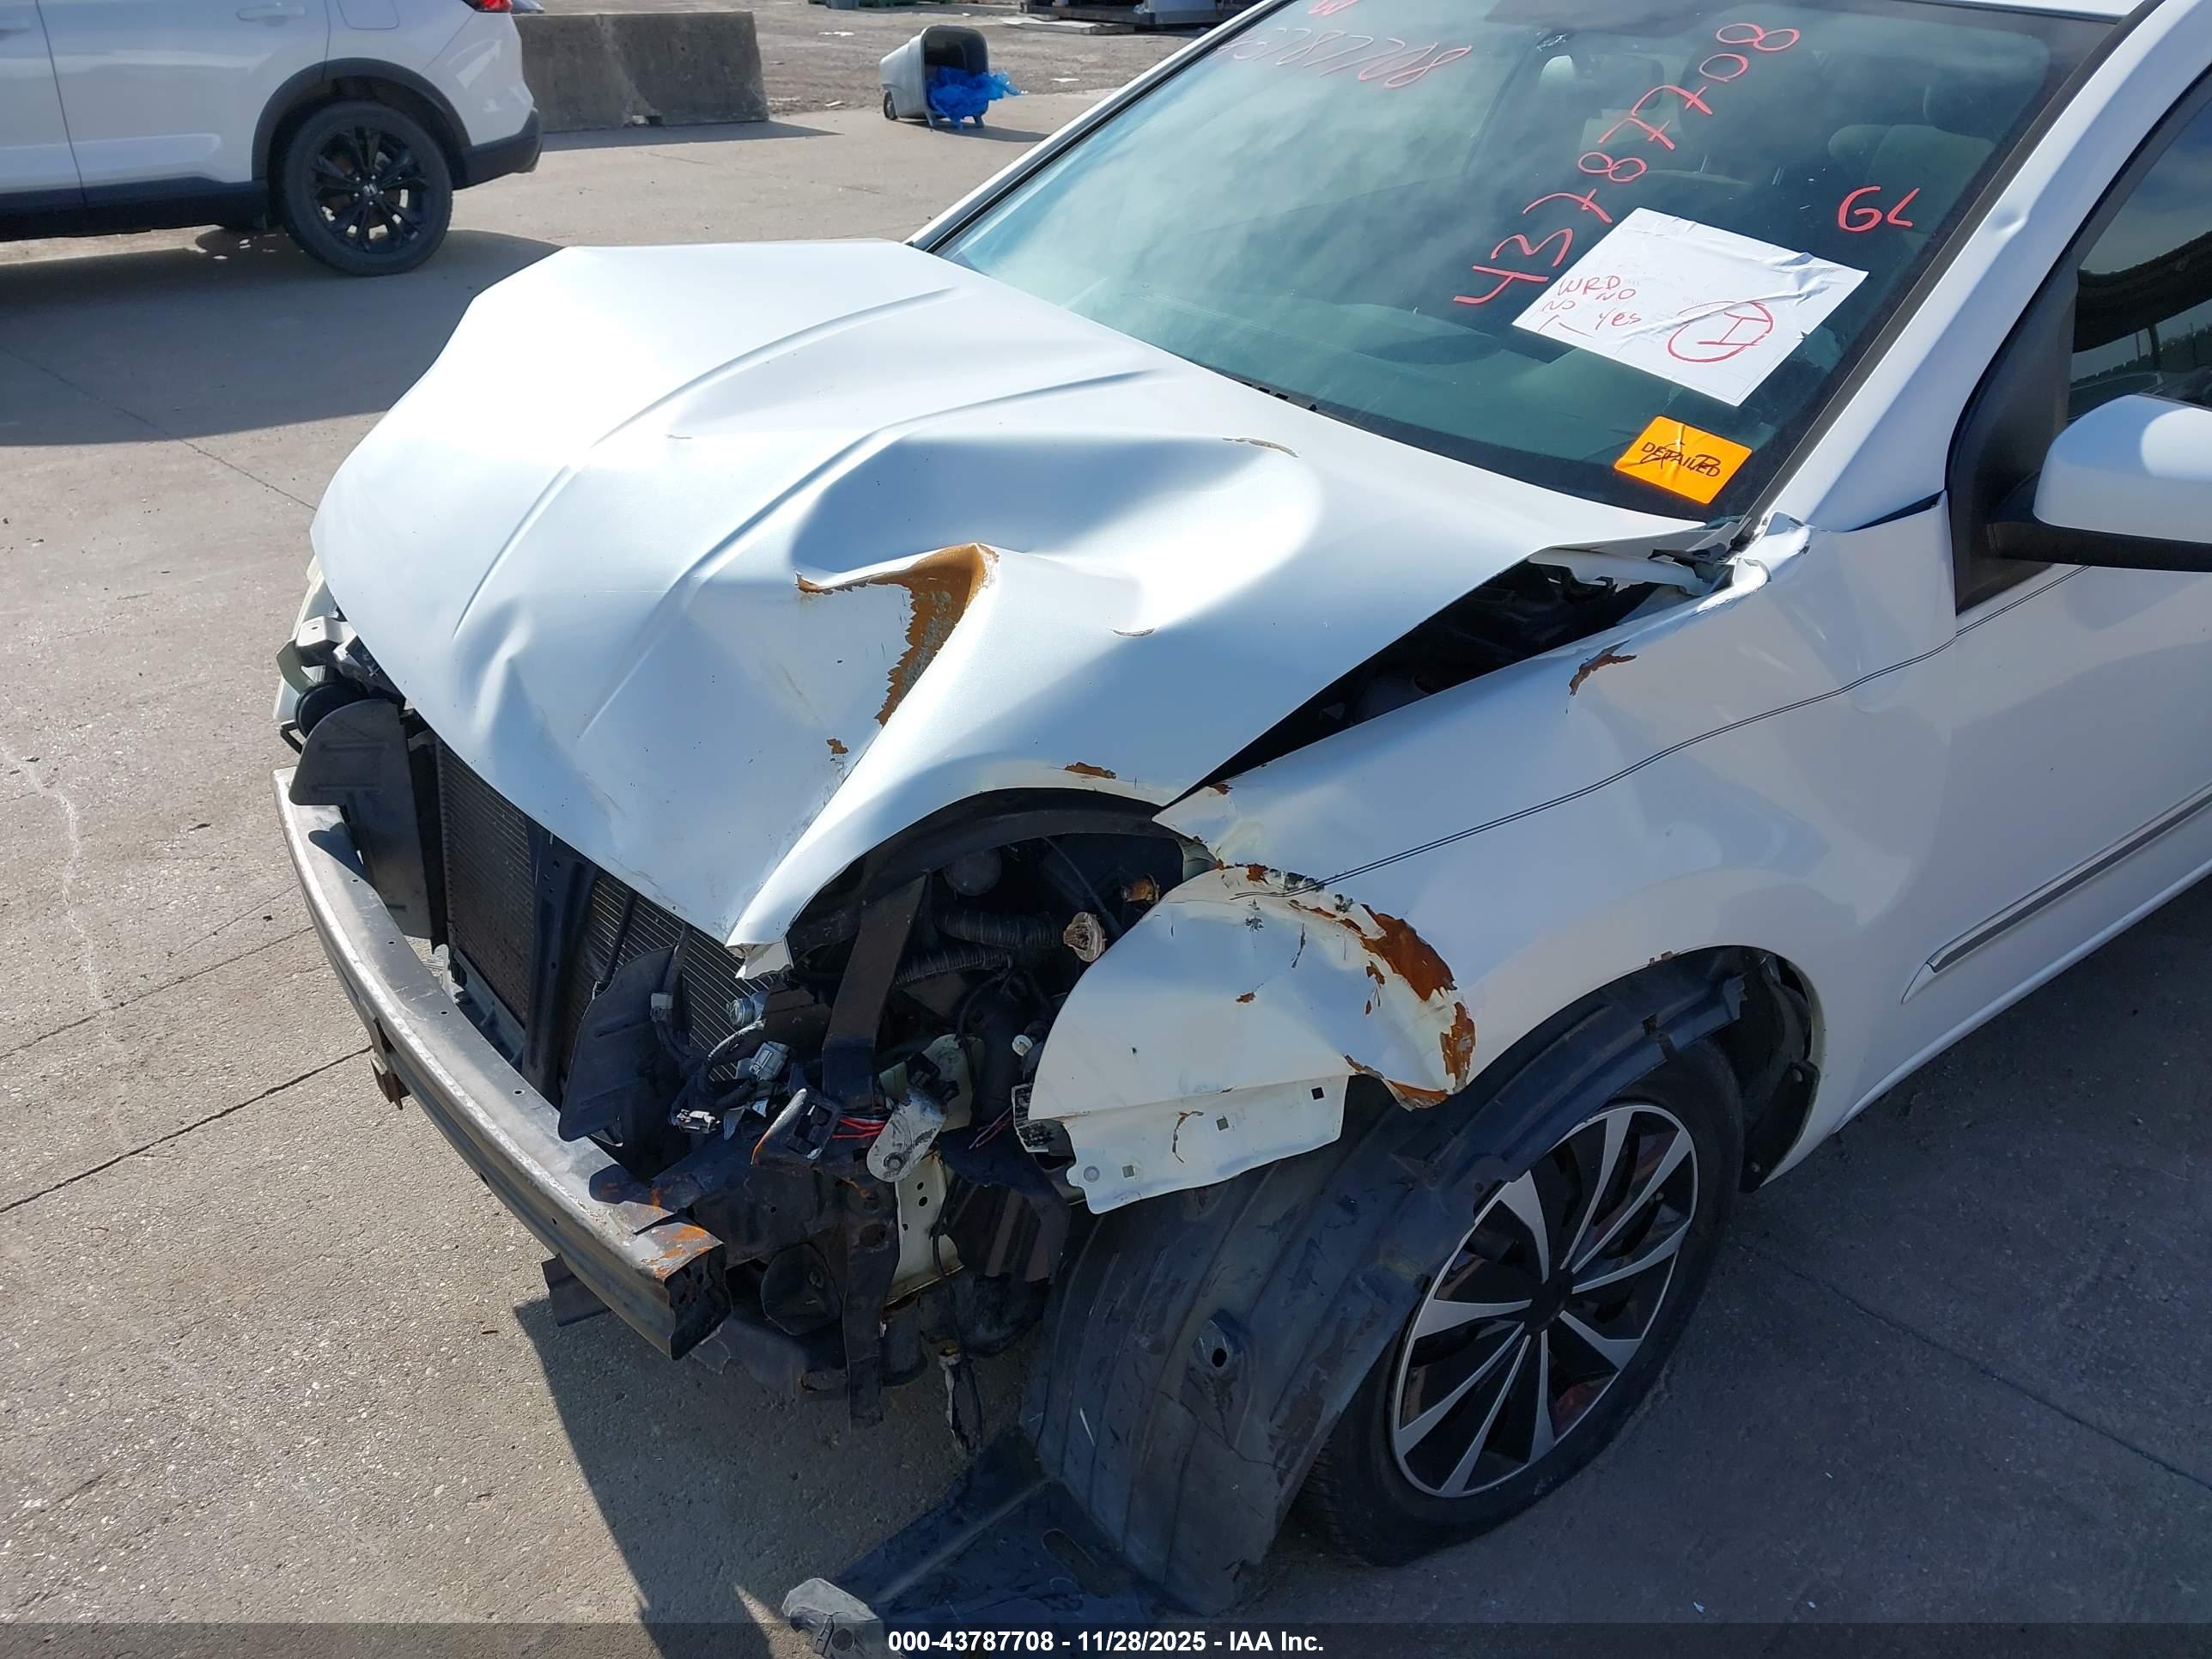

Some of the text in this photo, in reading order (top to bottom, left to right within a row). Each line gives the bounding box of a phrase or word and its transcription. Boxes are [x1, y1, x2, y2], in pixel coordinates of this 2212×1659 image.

[1454, 22, 1801, 305] 43787708
[1838, 185, 1921, 233] GL
[1557, 275, 1621, 295] WRD
[1641, 441, 1721, 477] DETAILED
